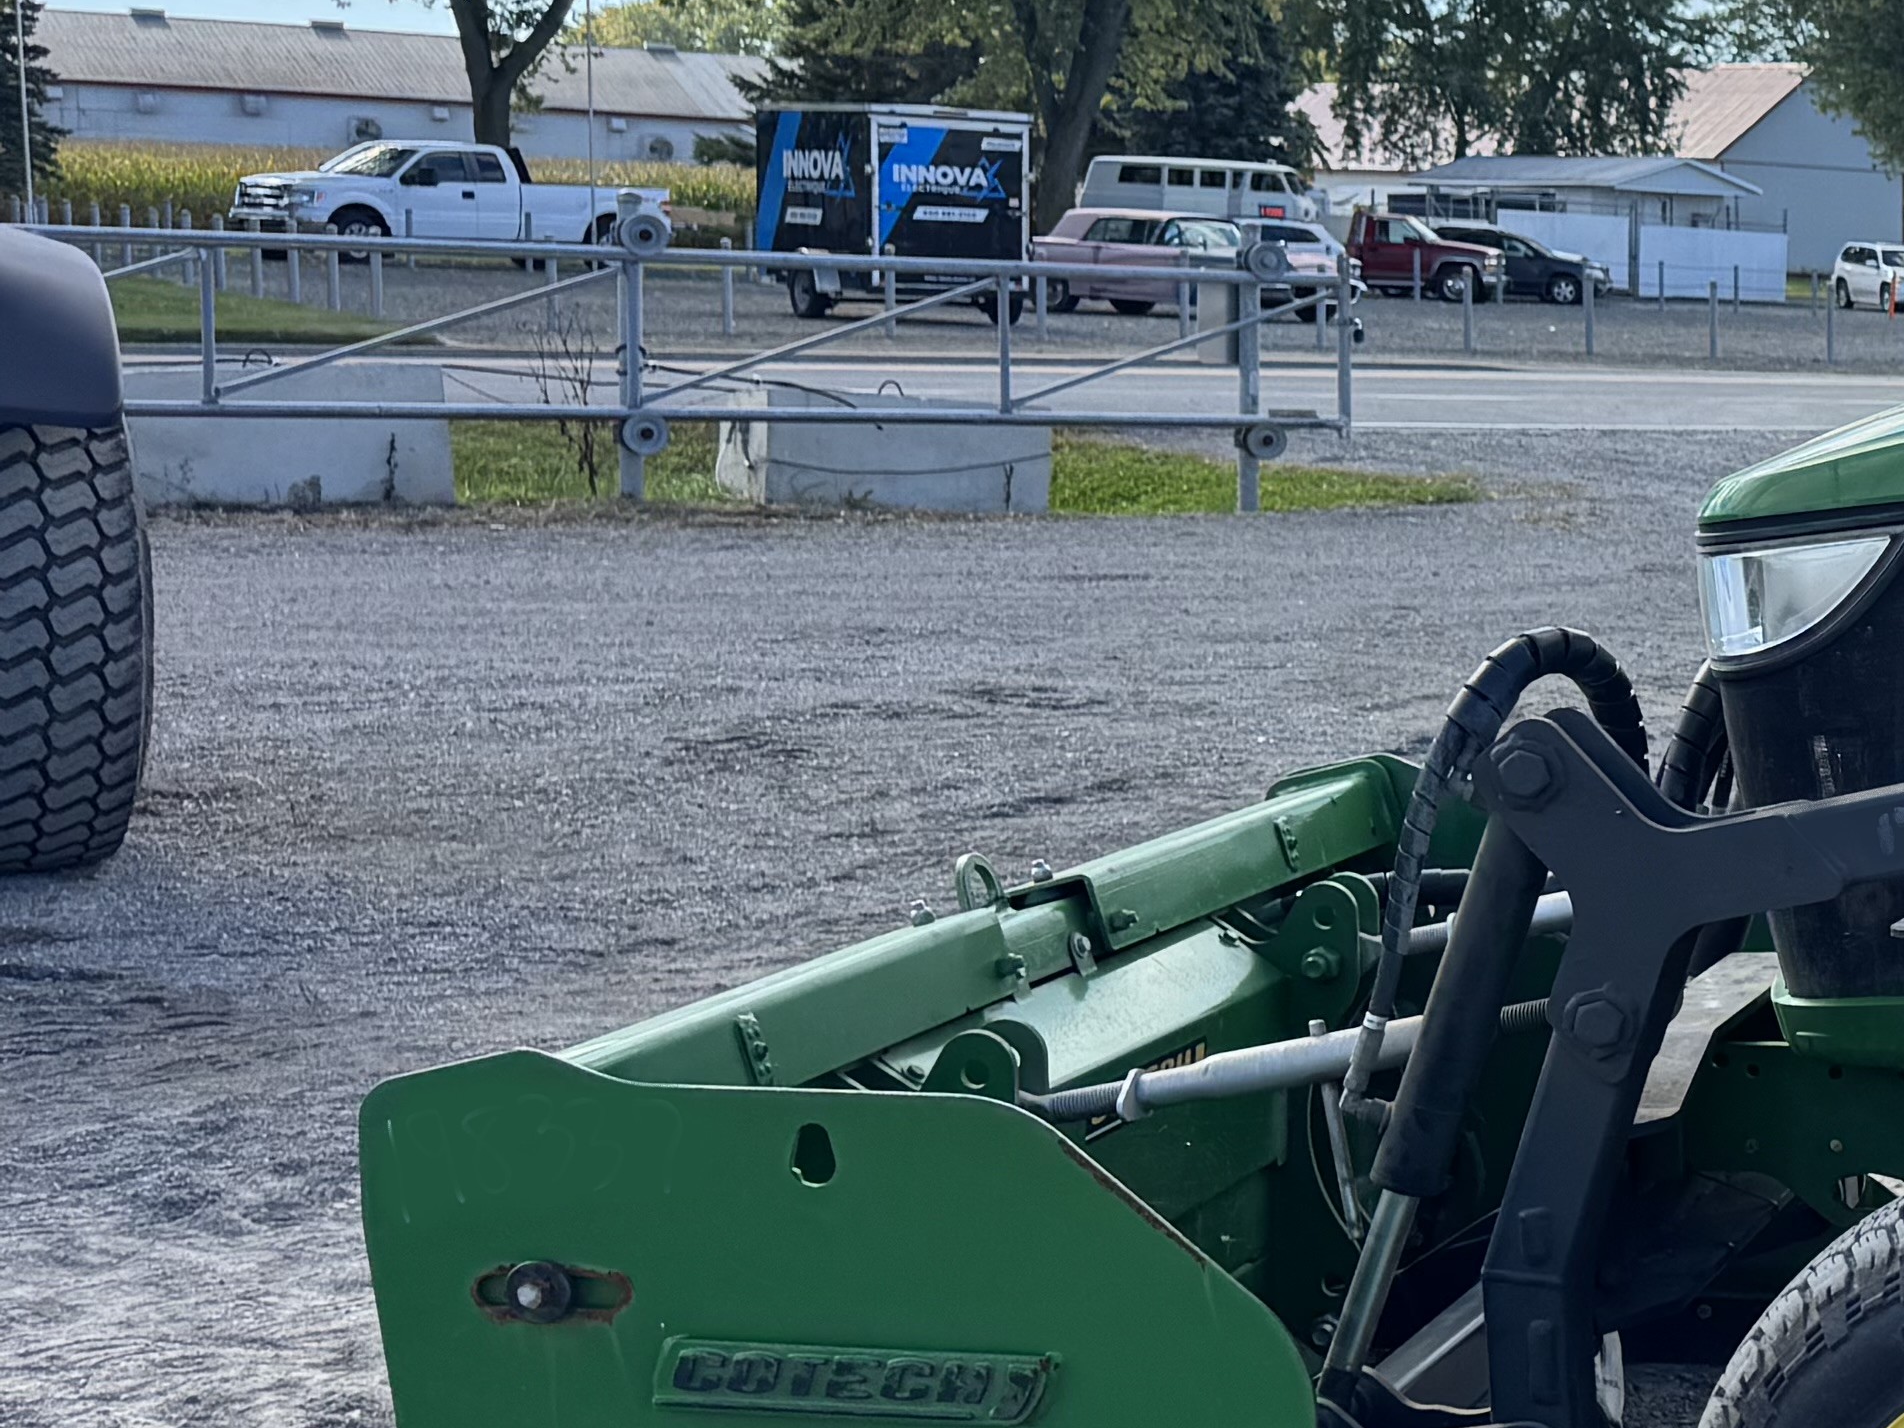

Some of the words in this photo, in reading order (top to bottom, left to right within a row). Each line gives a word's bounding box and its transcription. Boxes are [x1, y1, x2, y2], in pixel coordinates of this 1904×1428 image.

[783, 149, 844, 180] INNOVA
[893, 163, 988, 187] INNOVA
[672, 1347, 991, 1405] COTECH
